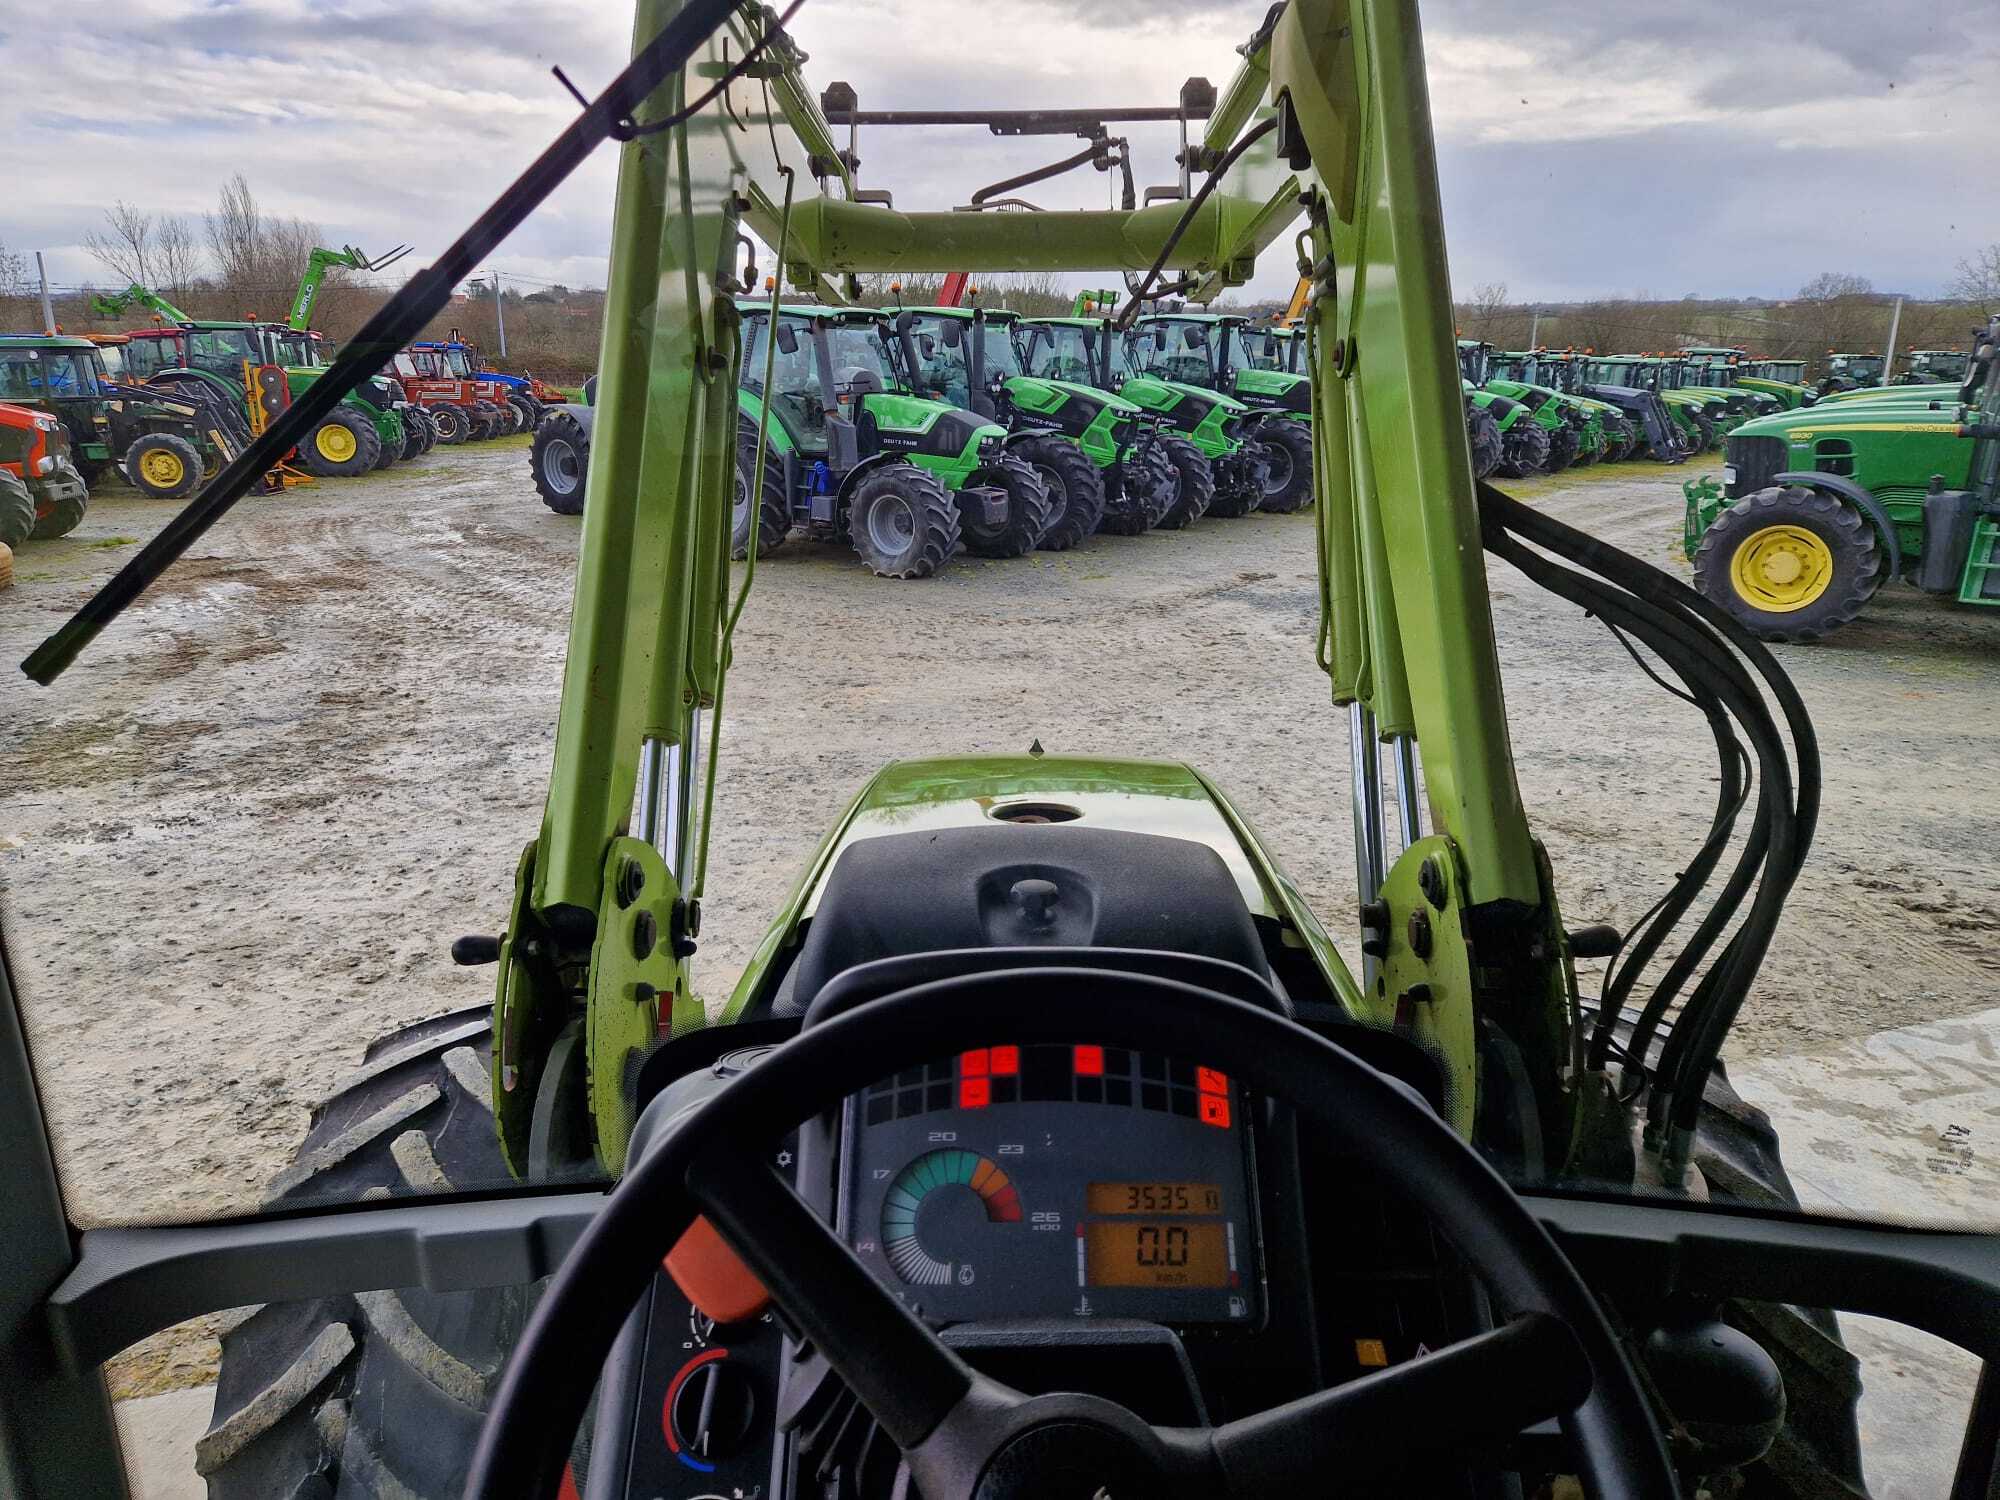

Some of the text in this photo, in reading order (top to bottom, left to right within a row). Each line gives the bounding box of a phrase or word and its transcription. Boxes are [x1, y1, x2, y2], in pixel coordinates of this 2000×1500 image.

[296, 284, 314, 320] MERLO
[928, 1131, 957, 1142] 20
[997, 1144, 1025, 1155] 23
[872, 1169, 891, 1180] 17
[1127, 1186, 1189, 1210] 3535
[1031, 1212, 1061, 1223] 26
[855, 1242, 876, 1253] 14
[1136, 1226, 1190, 1267] 0.0
